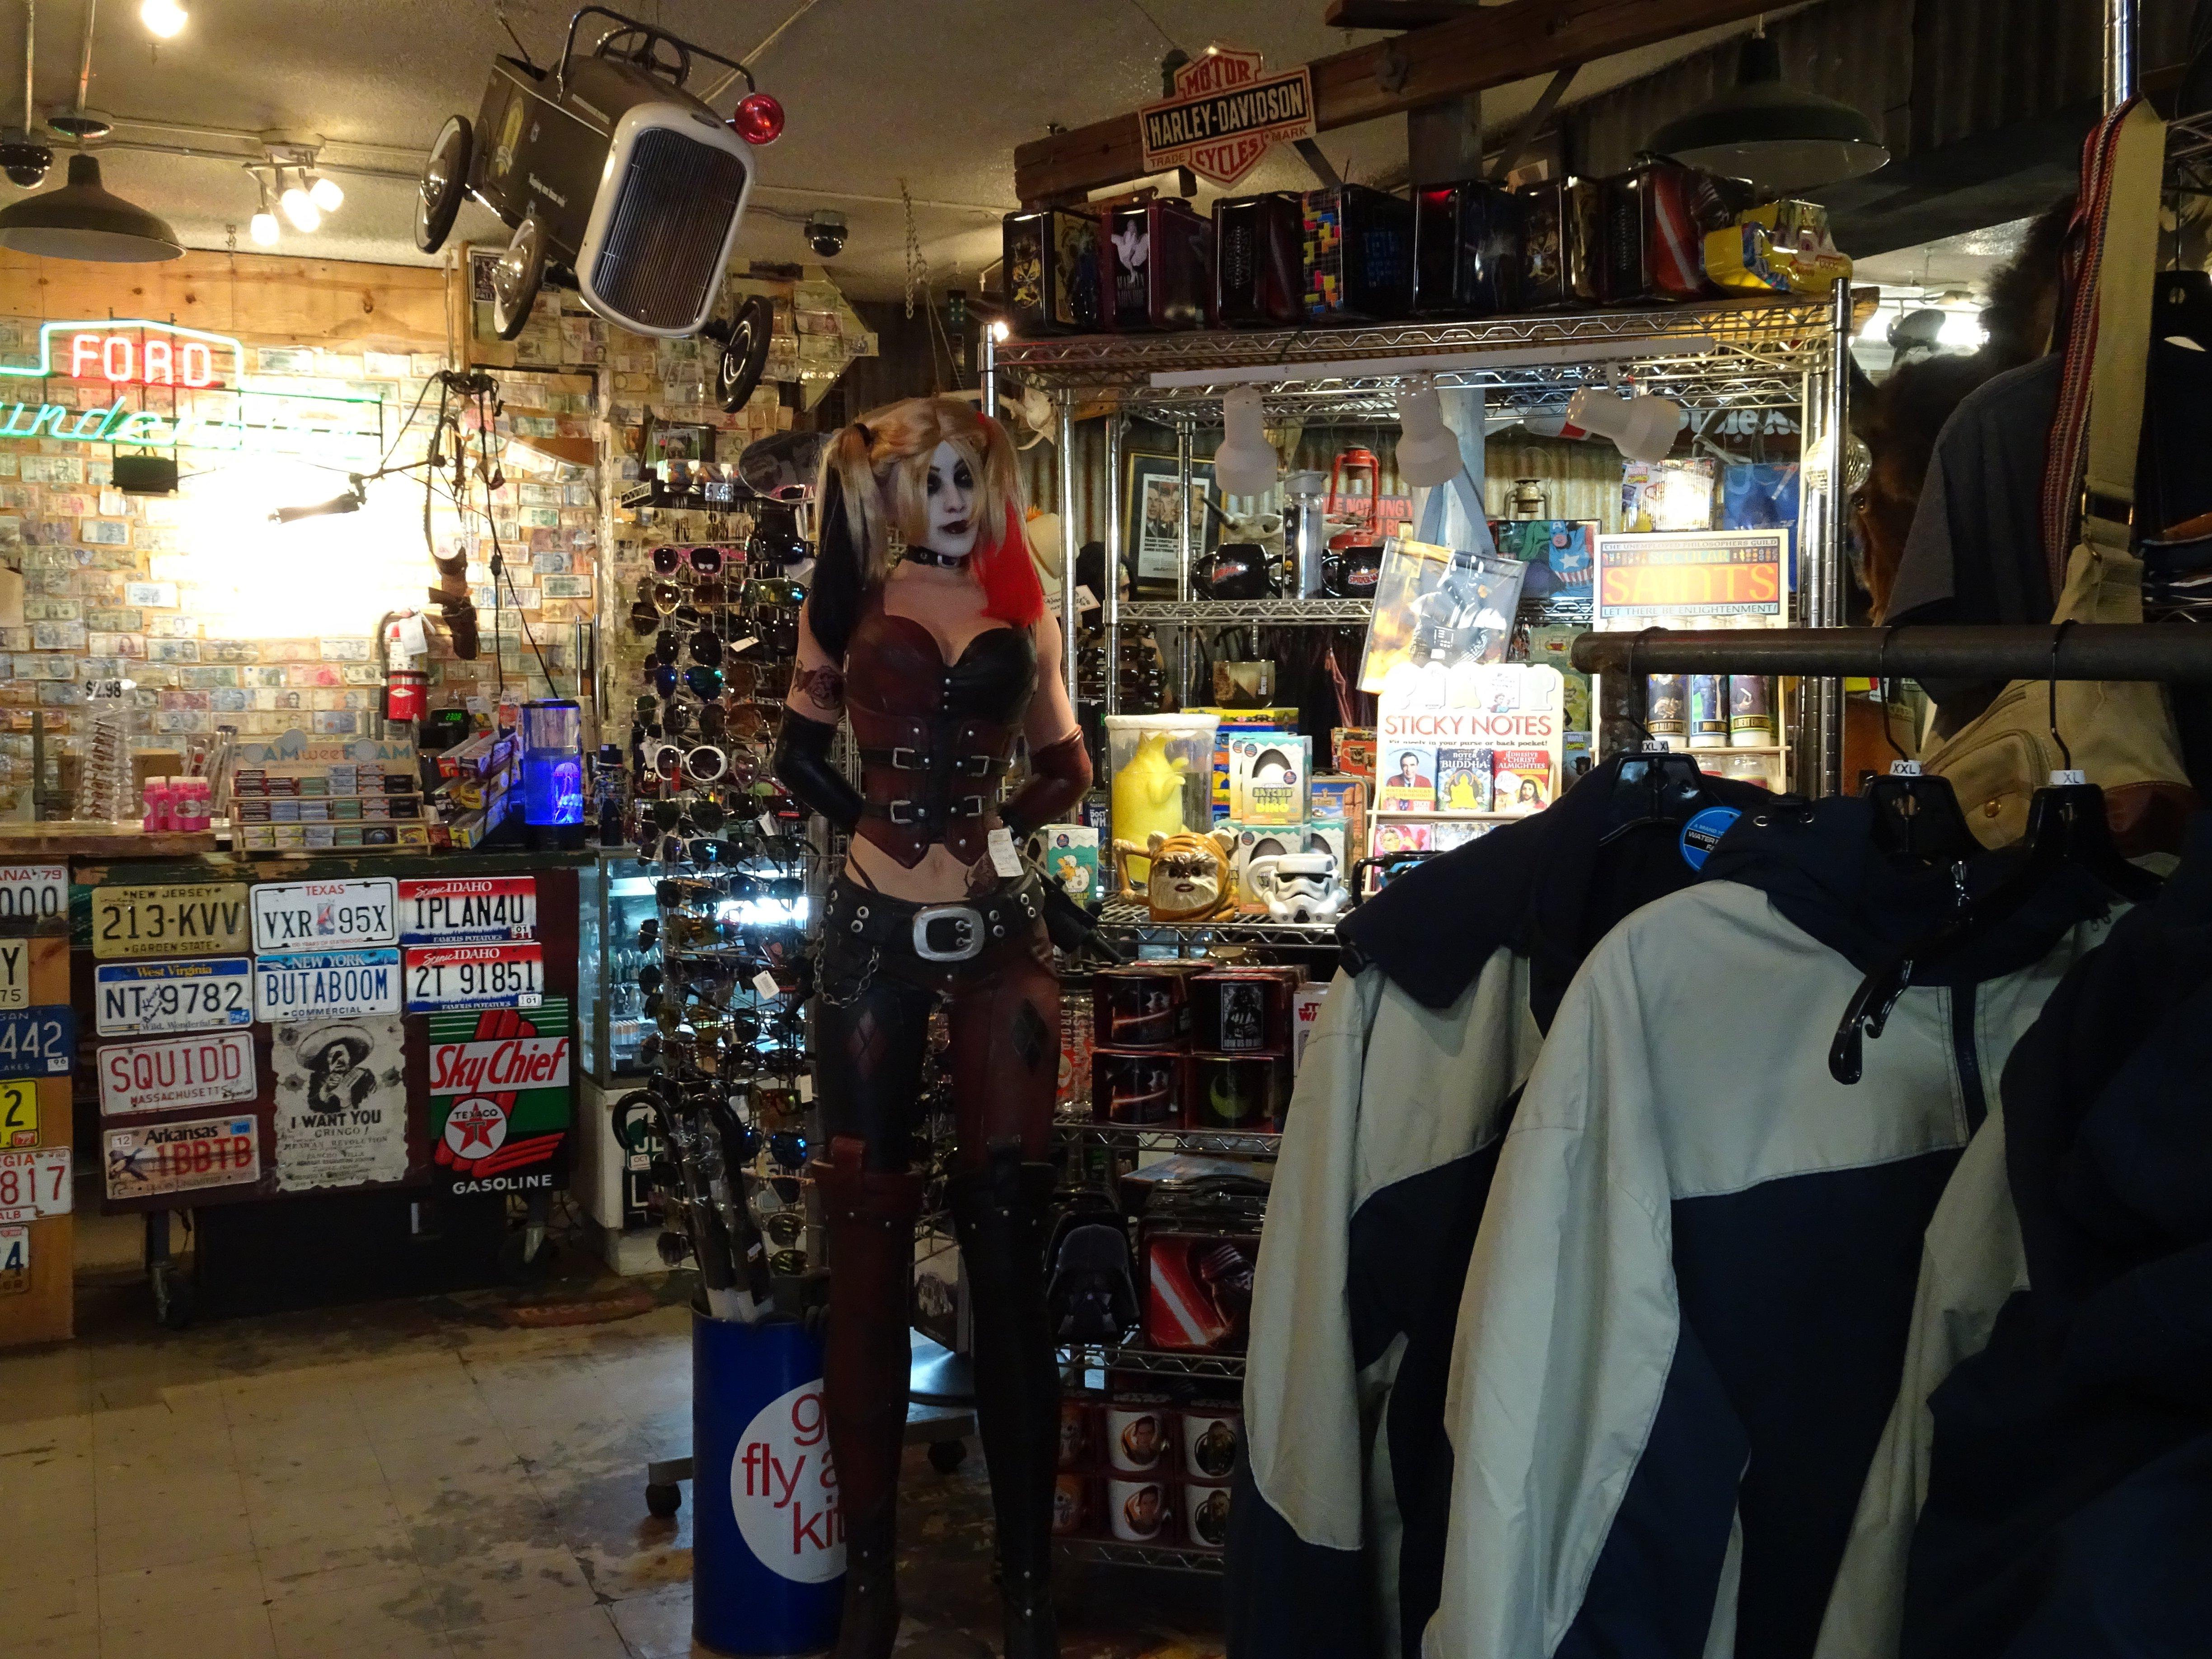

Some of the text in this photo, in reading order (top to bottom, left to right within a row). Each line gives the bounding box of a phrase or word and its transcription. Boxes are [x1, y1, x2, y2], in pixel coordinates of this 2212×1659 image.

[1185, 56, 1251, 96] MOTOR
[1149, 81, 1304, 148] HARLEY-DAVIDSON
[1150, 152, 1186, 168] TRADE
[1195, 136, 1259, 176] CYCLES
[71, 333, 212, 388] FORD
[1649, 549, 1729, 563] SECULAR
[1604, 565, 1776, 604] SAINTS
[1604, 607, 1622, 616] LET
[1626, 606, 1657, 615] THERE
[1679, 604, 1777, 614] ENLIGHTENMENT!
[85, 680, 122, 700] $2.98
[1384, 715, 1551, 736] STICKY NOTES
[1441, 760, 1488, 769] BUDDHA
[1893, 762, 1916, 774] XXL
[2063, 772, 2080, 783] XL
[1256, 803, 1289, 813] DINO
[0, 870, 32, 881] NA
[130, 888, 212, 899] NEW JERSEY
[305, 884, 345, 896] TEXAS
[415, 881, 492, 898] Scenic IDAHO
[102, 902, 239, 940] 213-KVV
[415, 894, 524, 929] IPLAN4U
[264, 905, 387, 939] VXR 95X
[132, 941, 212, 954] GARDEN STATE
[433, 935, 464, 943] FAMOUS
[291, 954, 365, 970] NEW YORK
[423, 948, 500, 966] Scenic IDAHO
[137, 965, 212, 977] West Virginia
[415, 960, 535, 998] 2T 91851
[266, 968, 388, 1007] BUTABOOM
[106, 986, 146, 1019] NT
[160, 982, 243, 1015] 9782
[291, 1006, 362, 1017] COMMERCIAL
[0, 1021, 63, 1059] 442
[110, 1044, 241, 1094] SQUIDD
[430, 1037, 569, 1095] Sky Chief
[130, 1085, 228, 1105] MASSACHUSETTS
[4, 1089, 24, 1127] 2
[453, 1107, 498, 1120] TEXACO
[291, 1109, 382, 1129] I WANT YOU
[117, 1137, 130, 1145] 12
[144, 1126, 218, 1145] Arkansas
[0, 1165, 65, 1205] 817
[452, 1174, 553, 1195] GASOLINE
[741, 1442, 839, 1509] fly a
